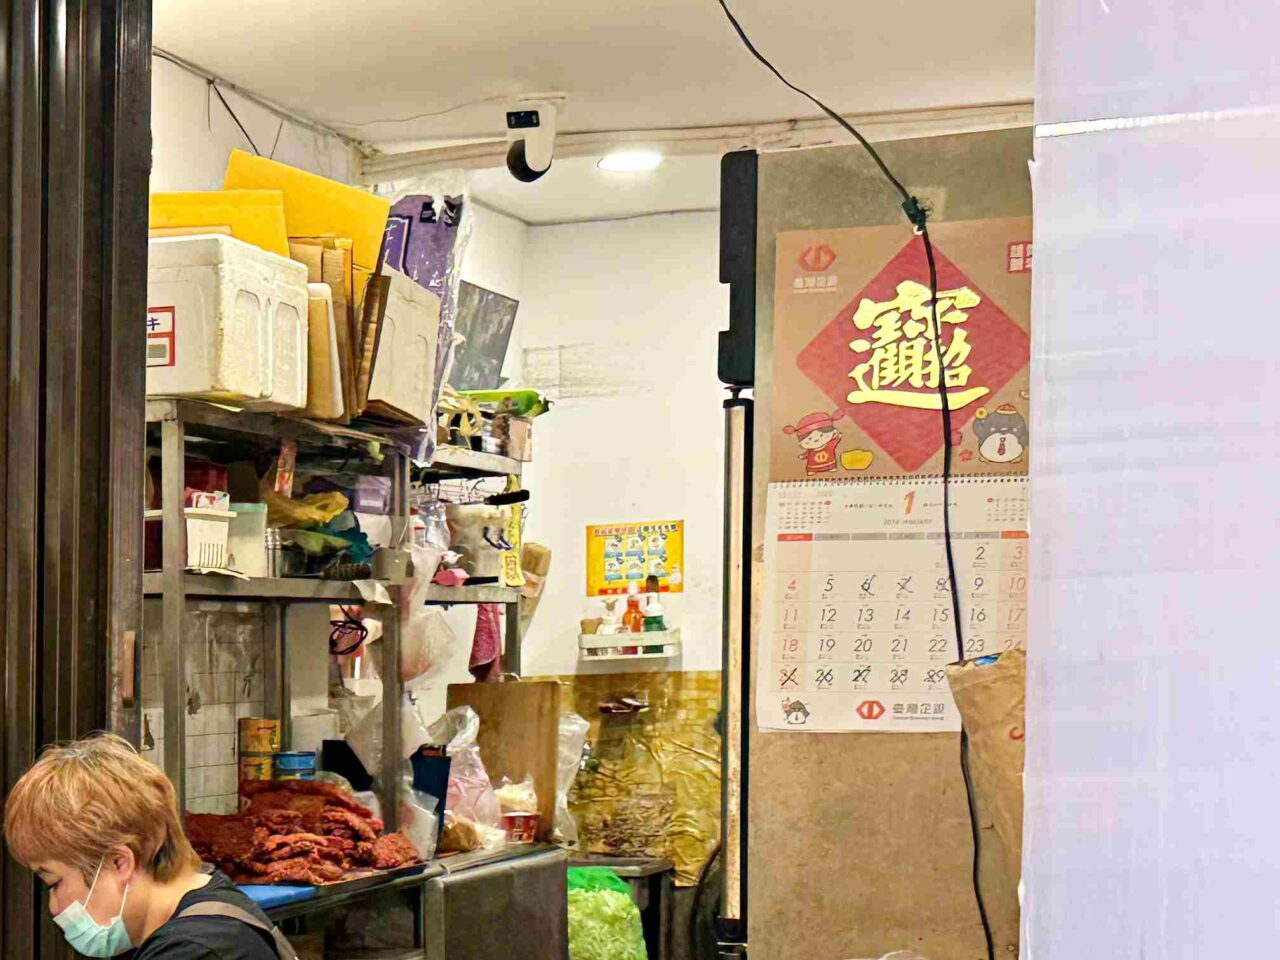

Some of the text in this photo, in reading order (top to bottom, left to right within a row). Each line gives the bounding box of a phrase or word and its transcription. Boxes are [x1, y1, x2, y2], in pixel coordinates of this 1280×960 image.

[904, 491, 916, 514] 1
[976, 546, 1024, 560] 2 3
[824, 578, 835, 592] 5
[974, 577, 984, 591] 9
[1009, 577, 1025, 591] 10
[784, 607, 1025, 622] 11 12 13 14 15 16 17
[783, 638, 799, 652] 18
[819, 638, 836, 652] 19
[854, 638, 873, 652] 20
[891, 638, 908, 652] 21
[928, 638, 948, 652] 22
[966, 638, 985, 653] 23
